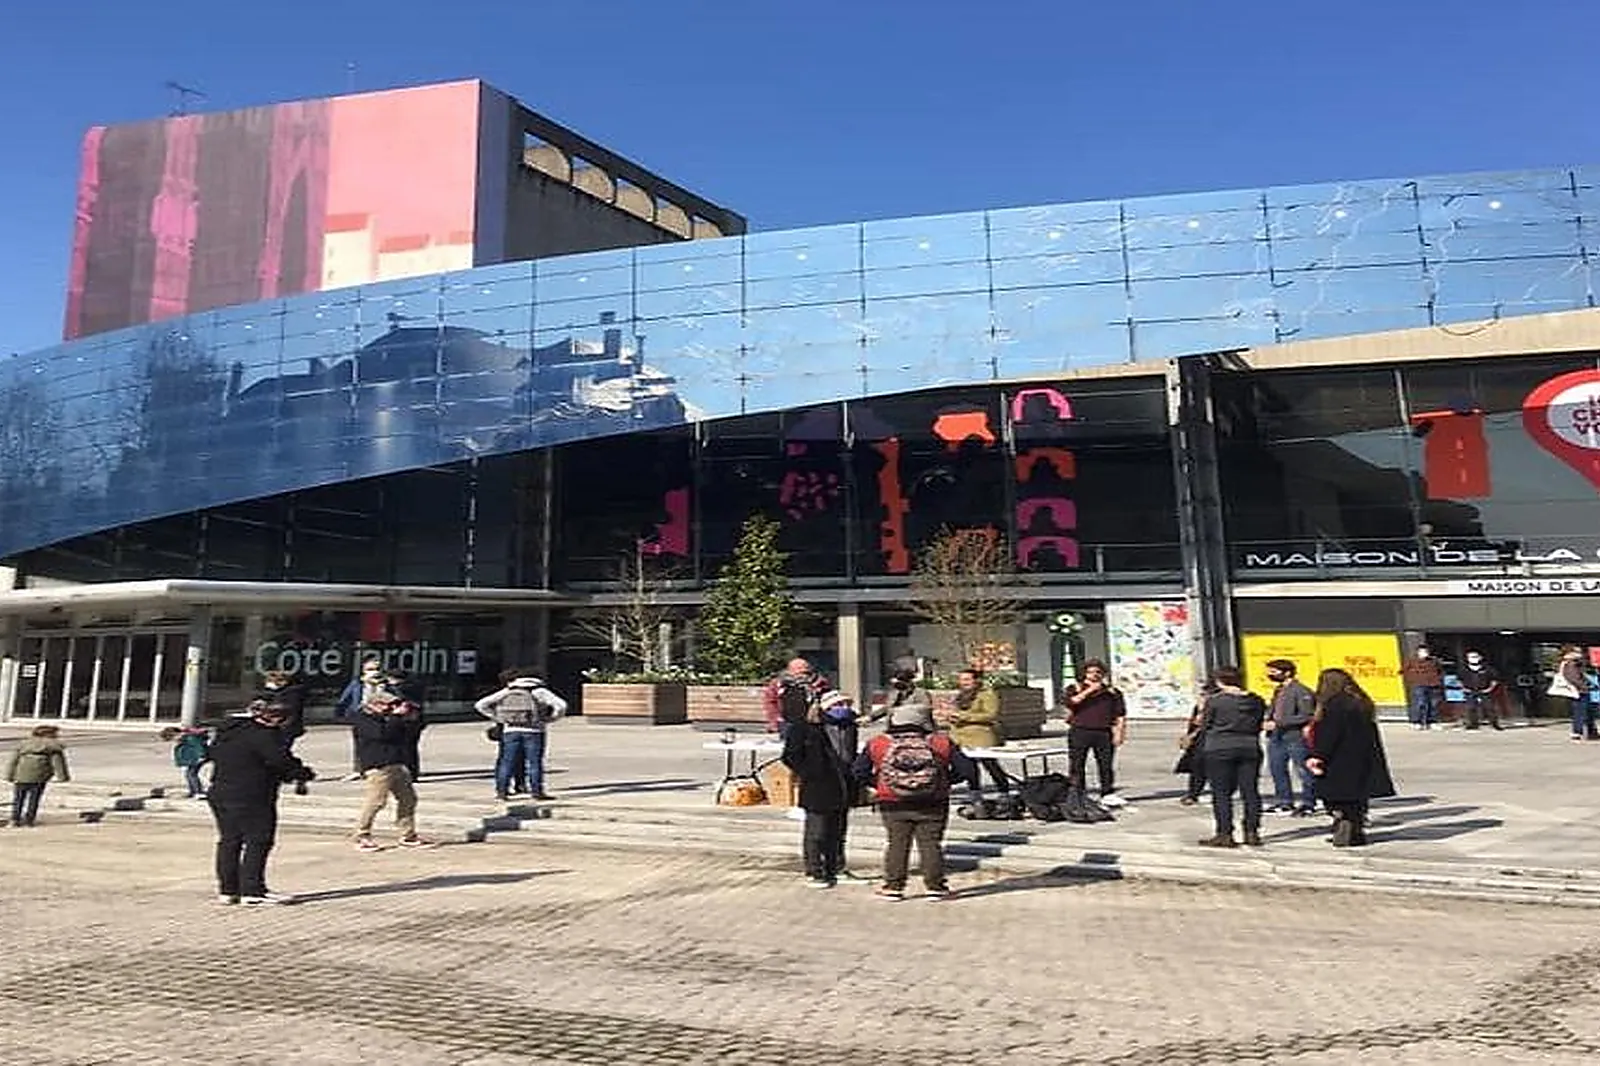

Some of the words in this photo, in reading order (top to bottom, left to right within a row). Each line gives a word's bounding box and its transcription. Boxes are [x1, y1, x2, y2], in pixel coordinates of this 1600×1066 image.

[1247, 552, 1418, 565] MAISON
[1435, 551, 1498, 562] DE
[1515, 549, 1582, 561] LA
[1468, 581, 1541, 592] MAISON
[1550, 581, 1575, 591] DE
[255, 641, 341, 675] Côté
